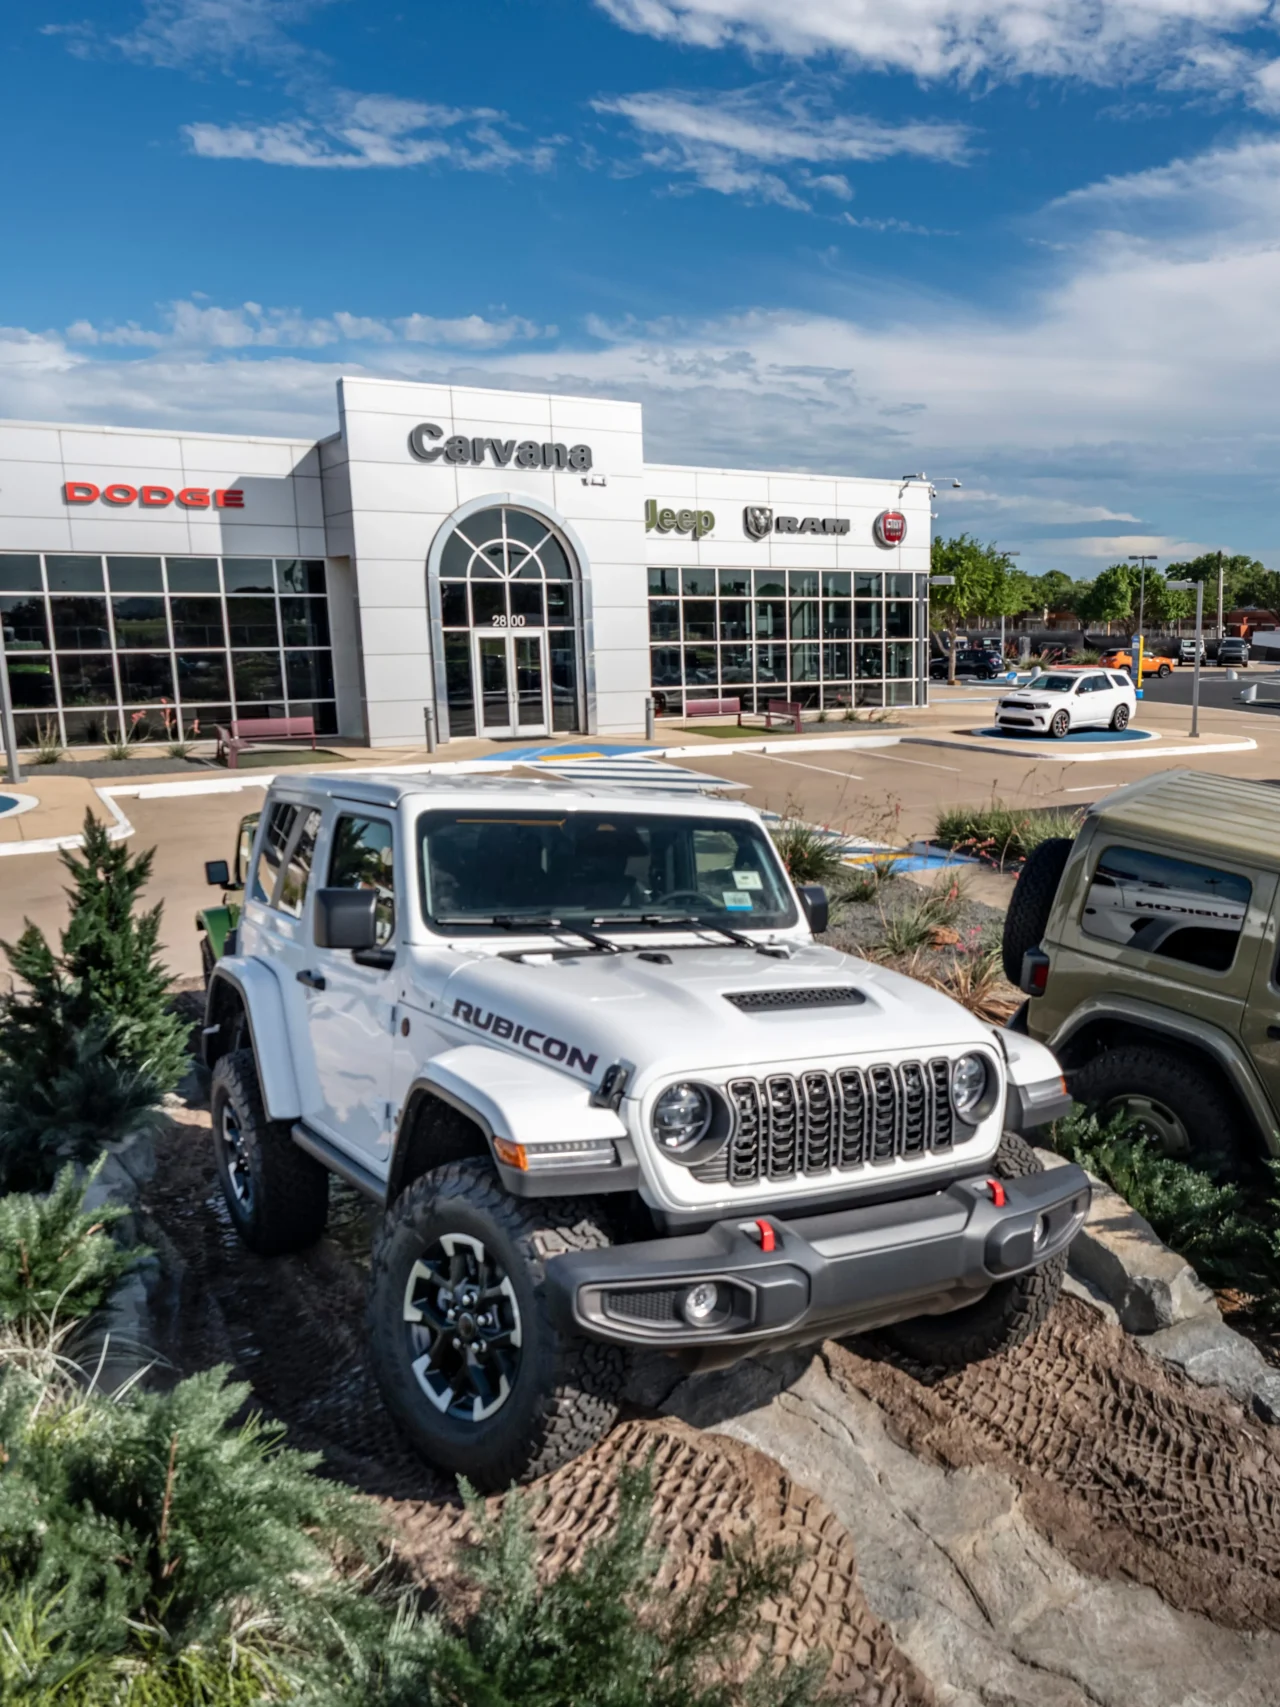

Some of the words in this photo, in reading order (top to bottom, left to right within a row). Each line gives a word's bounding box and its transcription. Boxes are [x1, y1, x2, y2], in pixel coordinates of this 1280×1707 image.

[408, 422, 593, 472] Carvana
[64, 481, 245, 509] DODGE
[645, 499, 715, 541] Jeep
[773, 516, 850, 536] RAM
[491, 614, 526, 627] 2800
[452, 999, 599, 1075] RUBICON
